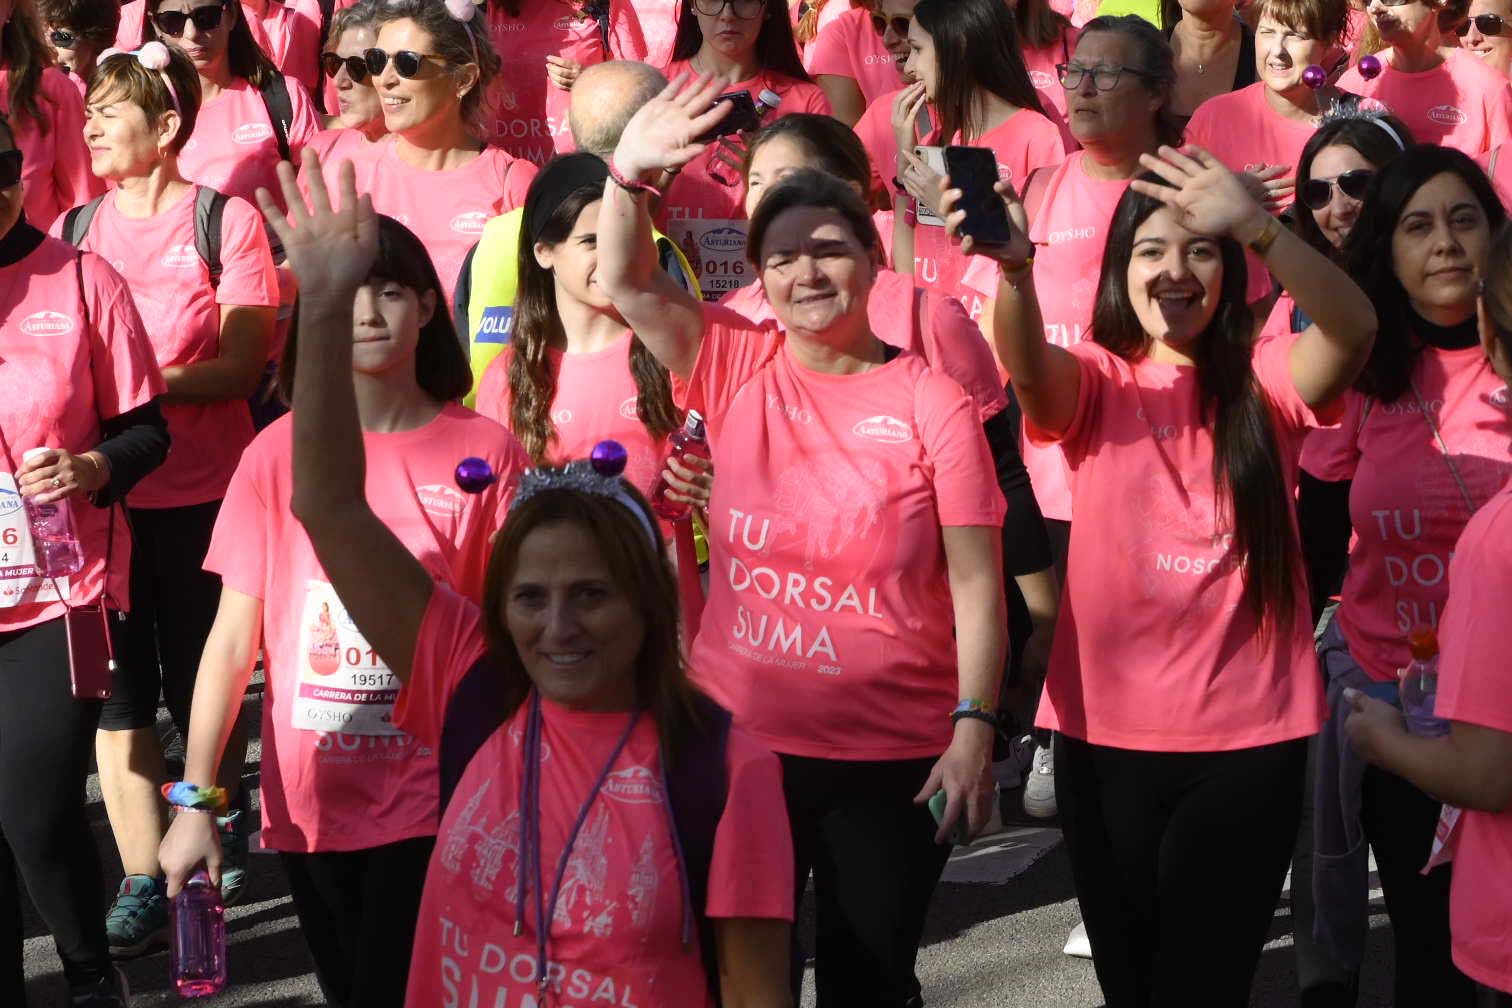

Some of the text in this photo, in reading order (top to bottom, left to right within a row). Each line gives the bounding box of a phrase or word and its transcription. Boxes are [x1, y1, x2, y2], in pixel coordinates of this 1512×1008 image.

[495, 117, 571, 138] DORSA
[1048, 226, 1096, 245] OYSHO
[705, 260, 744, 275] 016
[709, 279, 740, 290] 15218
[729, 508, 771, 551] TU
[1372, 509, 1422, 541] TU
[5, 566, 34, 578] MUJER
[729, 557, 884, 619] DORSAL
[732, 605, 838, 662] SUMA
[345, 646, 379, 667] 01
[350, 673, 394, 687] 19517
[312, 688, 382, 702] CARRERA DE LA
[306, 706, 353, 724] OYSHO
[439, 917, 641, 1008] TU DORSAL
